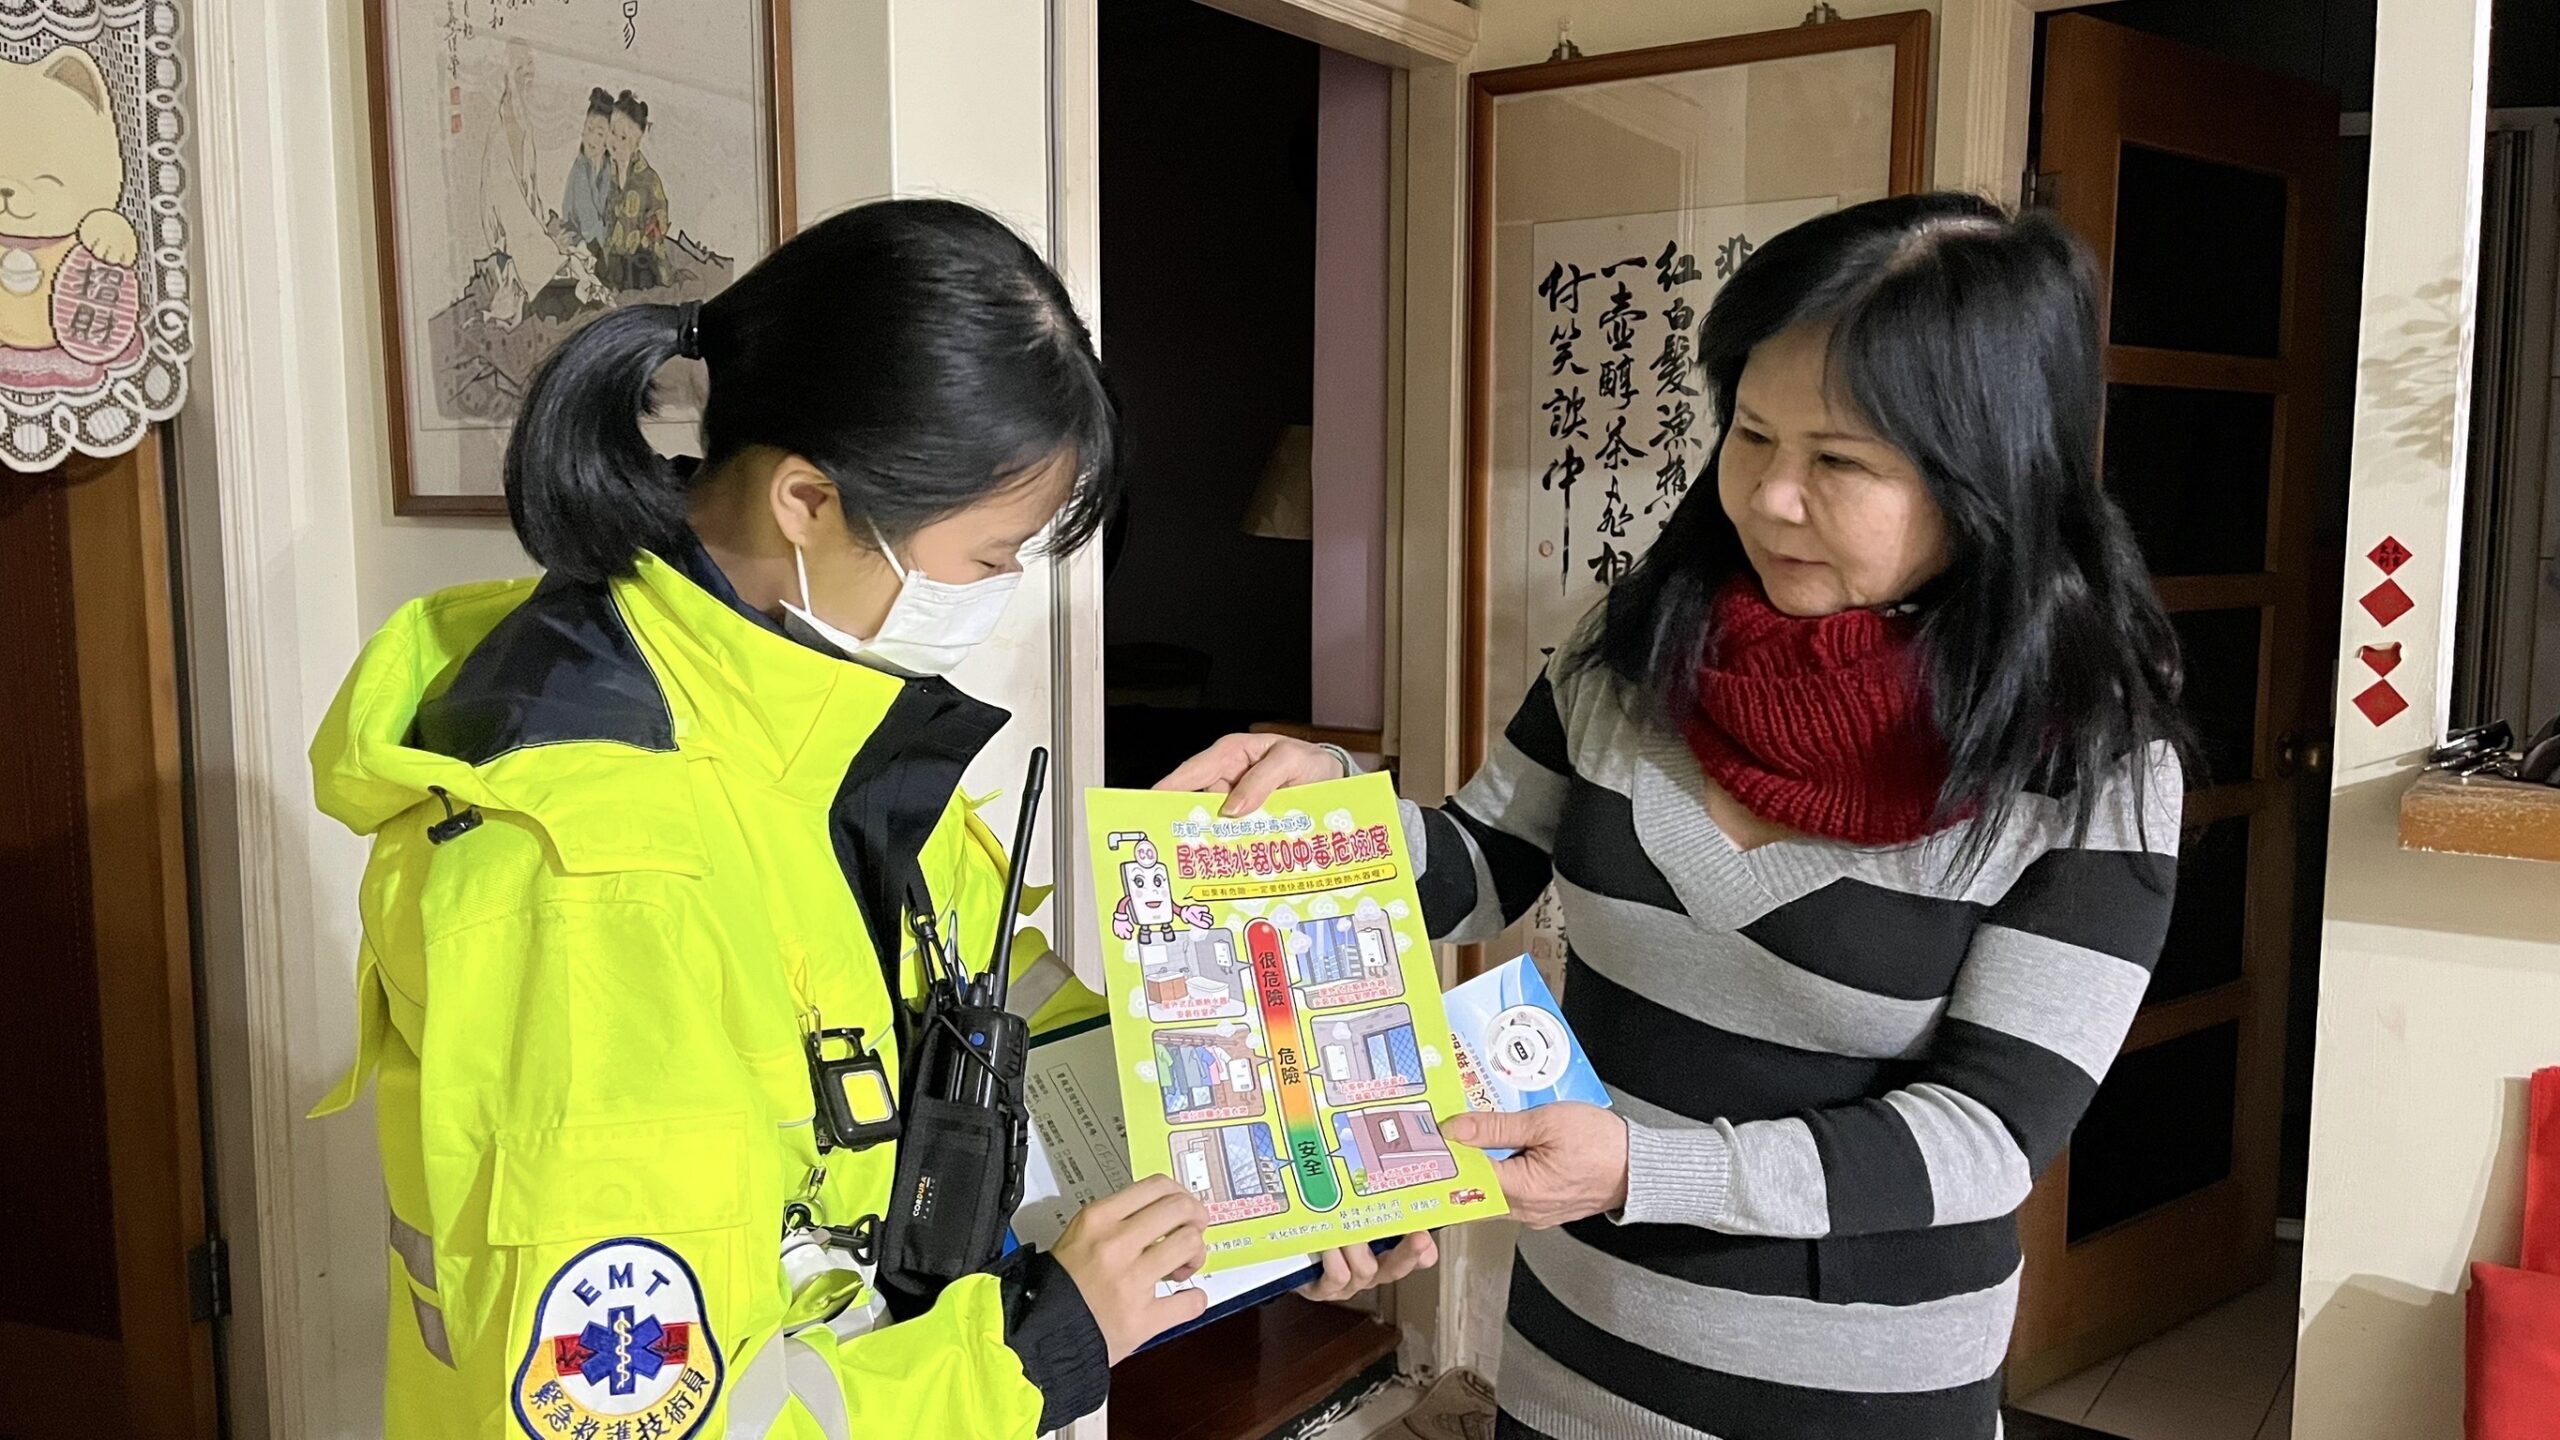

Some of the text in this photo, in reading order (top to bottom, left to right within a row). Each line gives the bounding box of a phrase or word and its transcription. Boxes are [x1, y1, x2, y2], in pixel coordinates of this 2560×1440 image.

[71, 261, 124, 343] 招財
[1645, 240, 1702, 530] 紅白髮漁樵
[1172, 816, 1311, 837] 防範一氧化碳中毒宣導
[1176, 824, 1393, 879] 居家熱水器CO中毒危險度
[1259, 952, 1285, 1006] 很危險
[1278, 1047, 1301, 1085] 危險
[1450, 1033, 1495, 1112] 災警報
[1298, 1141, 1322, 1176] 安全
[913, 1175, 929, 1217] CORDURA
[572, 1262, 670, 1307] EMT
